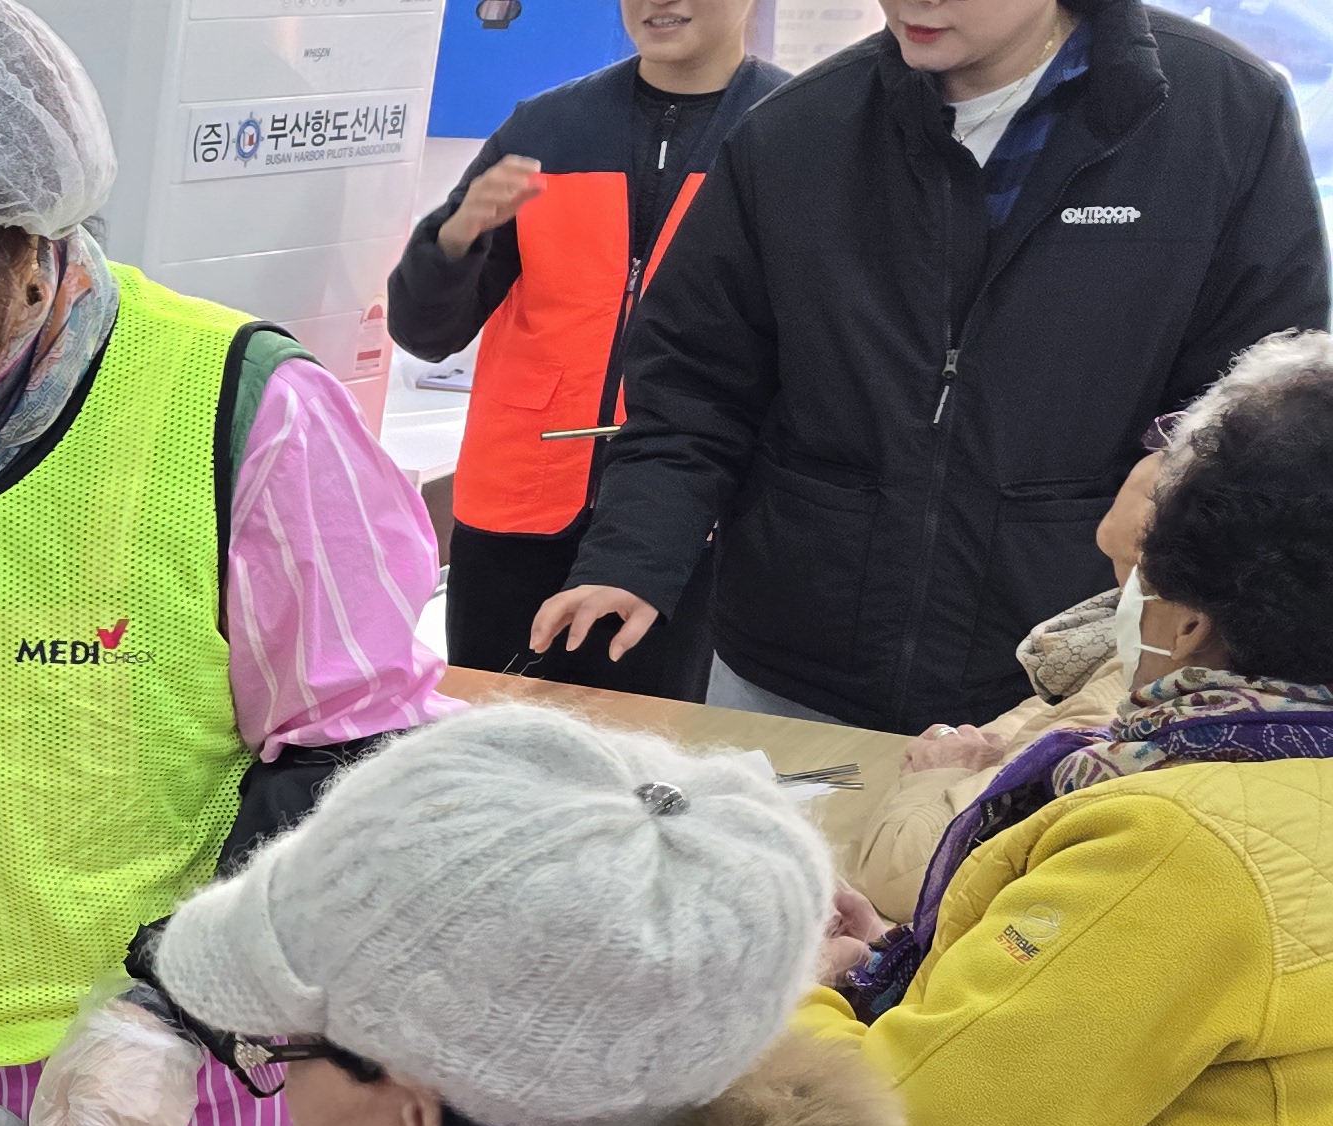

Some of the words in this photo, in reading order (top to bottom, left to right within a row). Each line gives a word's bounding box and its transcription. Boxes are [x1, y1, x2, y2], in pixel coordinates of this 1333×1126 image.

[303, 47, 331, 61] WHISEN
[193, 122, 230, 163] (증)
[267, 103, 407, 150] 부산항도선사회
[265, 152, 292, 165] BUSAN
[293, 149, 325, 162] HARBOR
[355, 142, 402, 157] ASSOCIATION
[15, 638, 100, 666] MEDI
[994, 933, 1032, 965] STYLE
[1003, 924, 1040, 958] EXTREME
